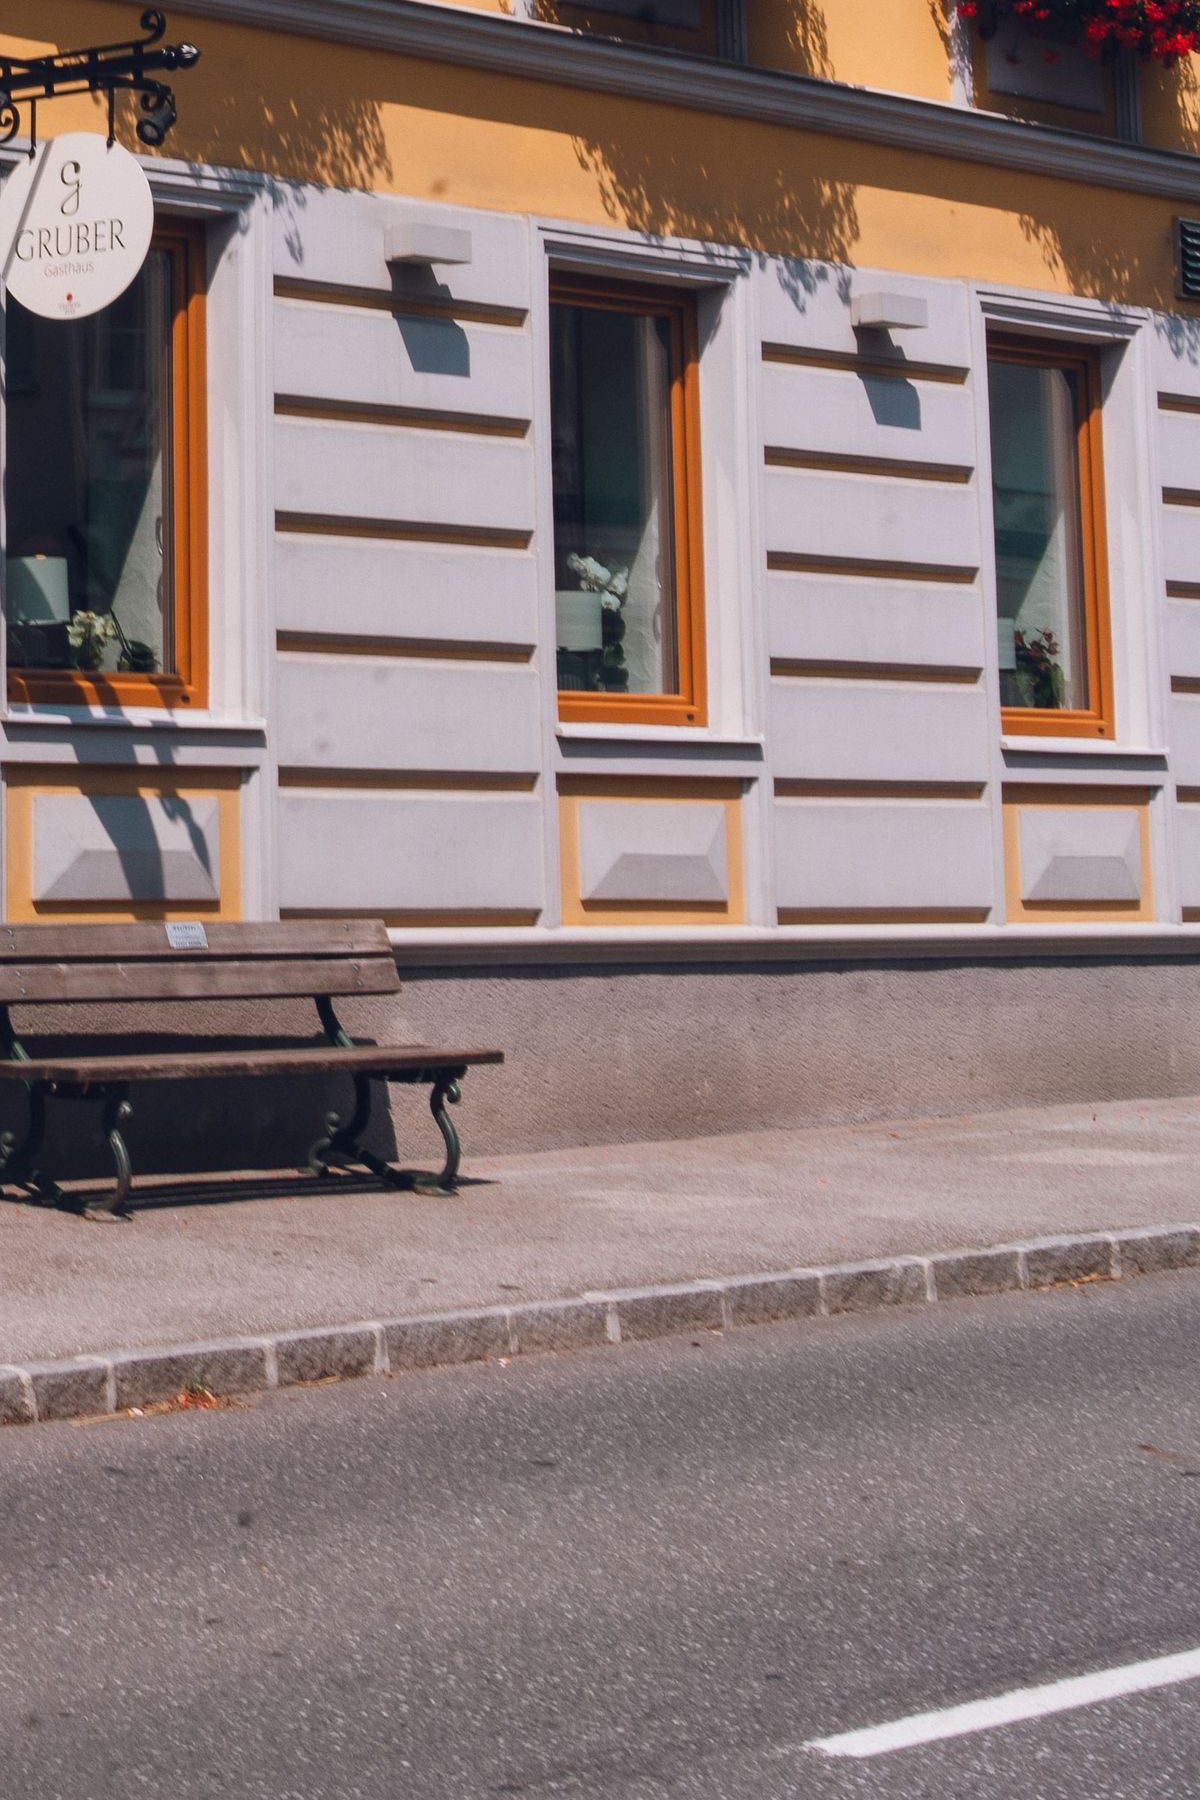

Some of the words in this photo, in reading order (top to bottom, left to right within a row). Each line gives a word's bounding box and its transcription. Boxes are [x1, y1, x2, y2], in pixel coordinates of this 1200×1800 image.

[60, 160, 81, 216] g
[15, 218, 126, 261] GRUBER
[44, 261, 95, 278] Gasthaus
